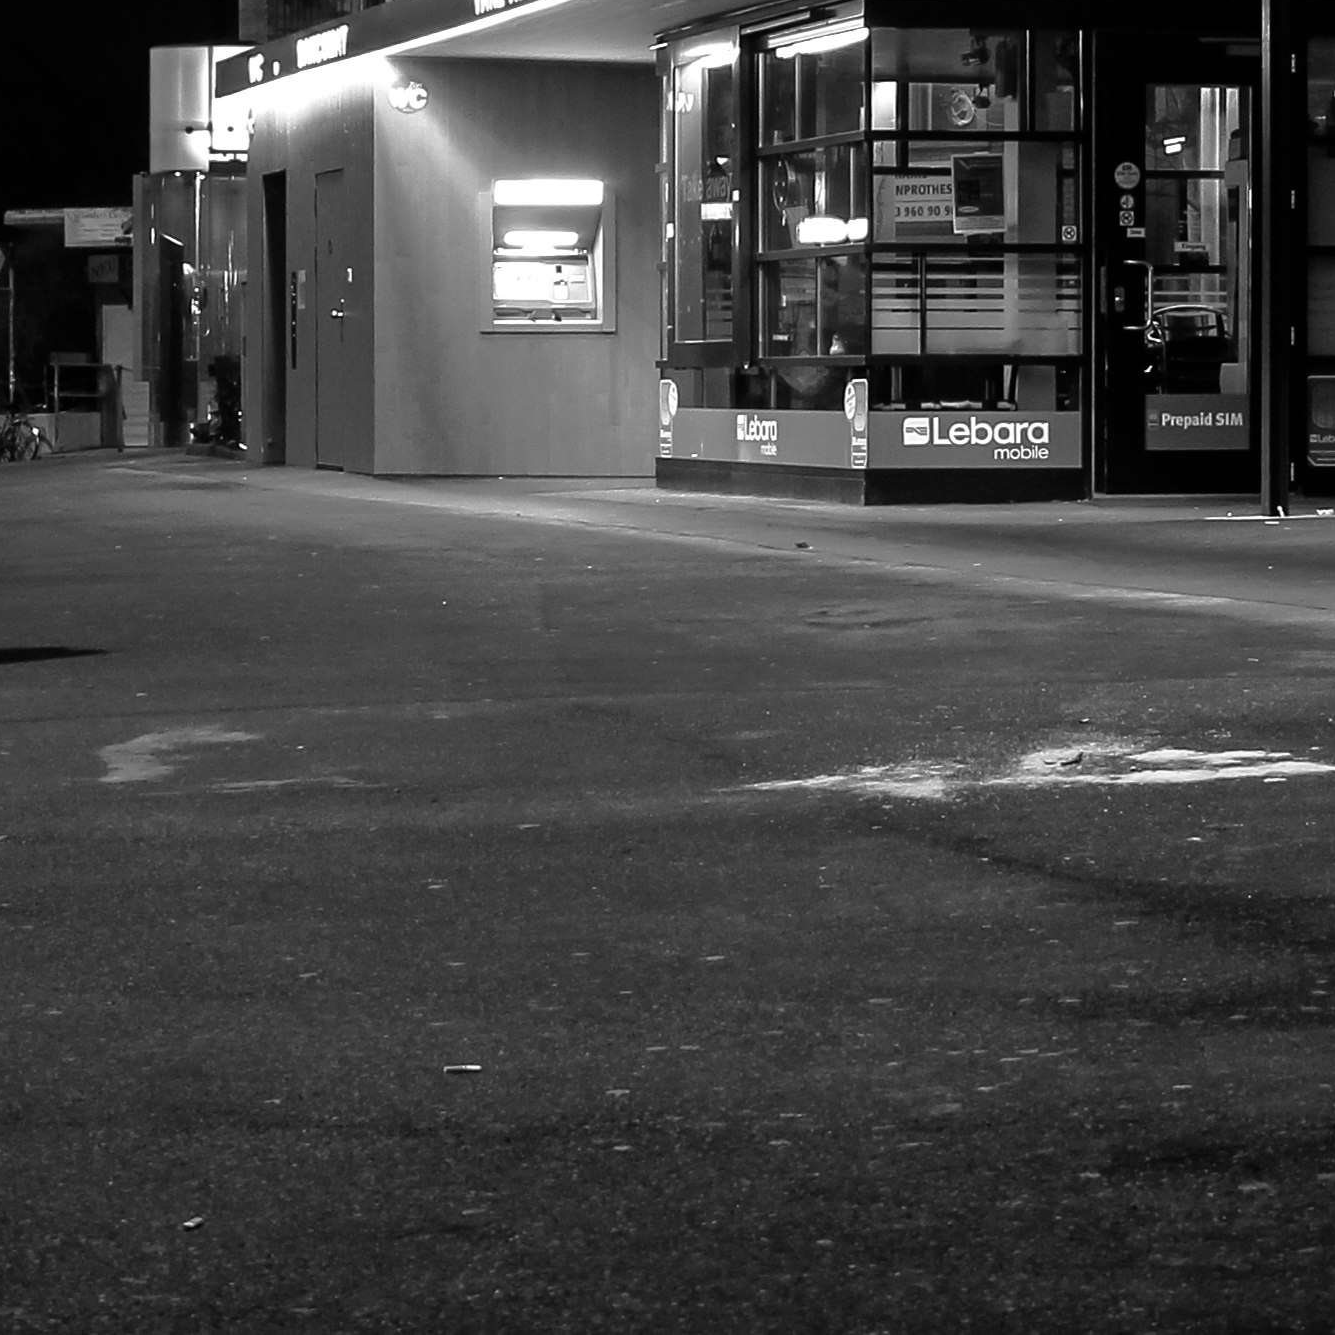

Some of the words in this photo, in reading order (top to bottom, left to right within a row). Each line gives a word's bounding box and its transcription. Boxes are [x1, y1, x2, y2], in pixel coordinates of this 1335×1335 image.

[388, 86, 428, 109] WC
[927, 205, 941, 217] 90
[745, 414, 778, 441] Lebara
[1161, 411, 1213, 430] Prepaid
[1215, 412, 1243, 426] SIM
[932, 416, 1050, 445] Lebara
[760, 442, 778, 456] mobile
[993, 445, 1050, 460] mobile
